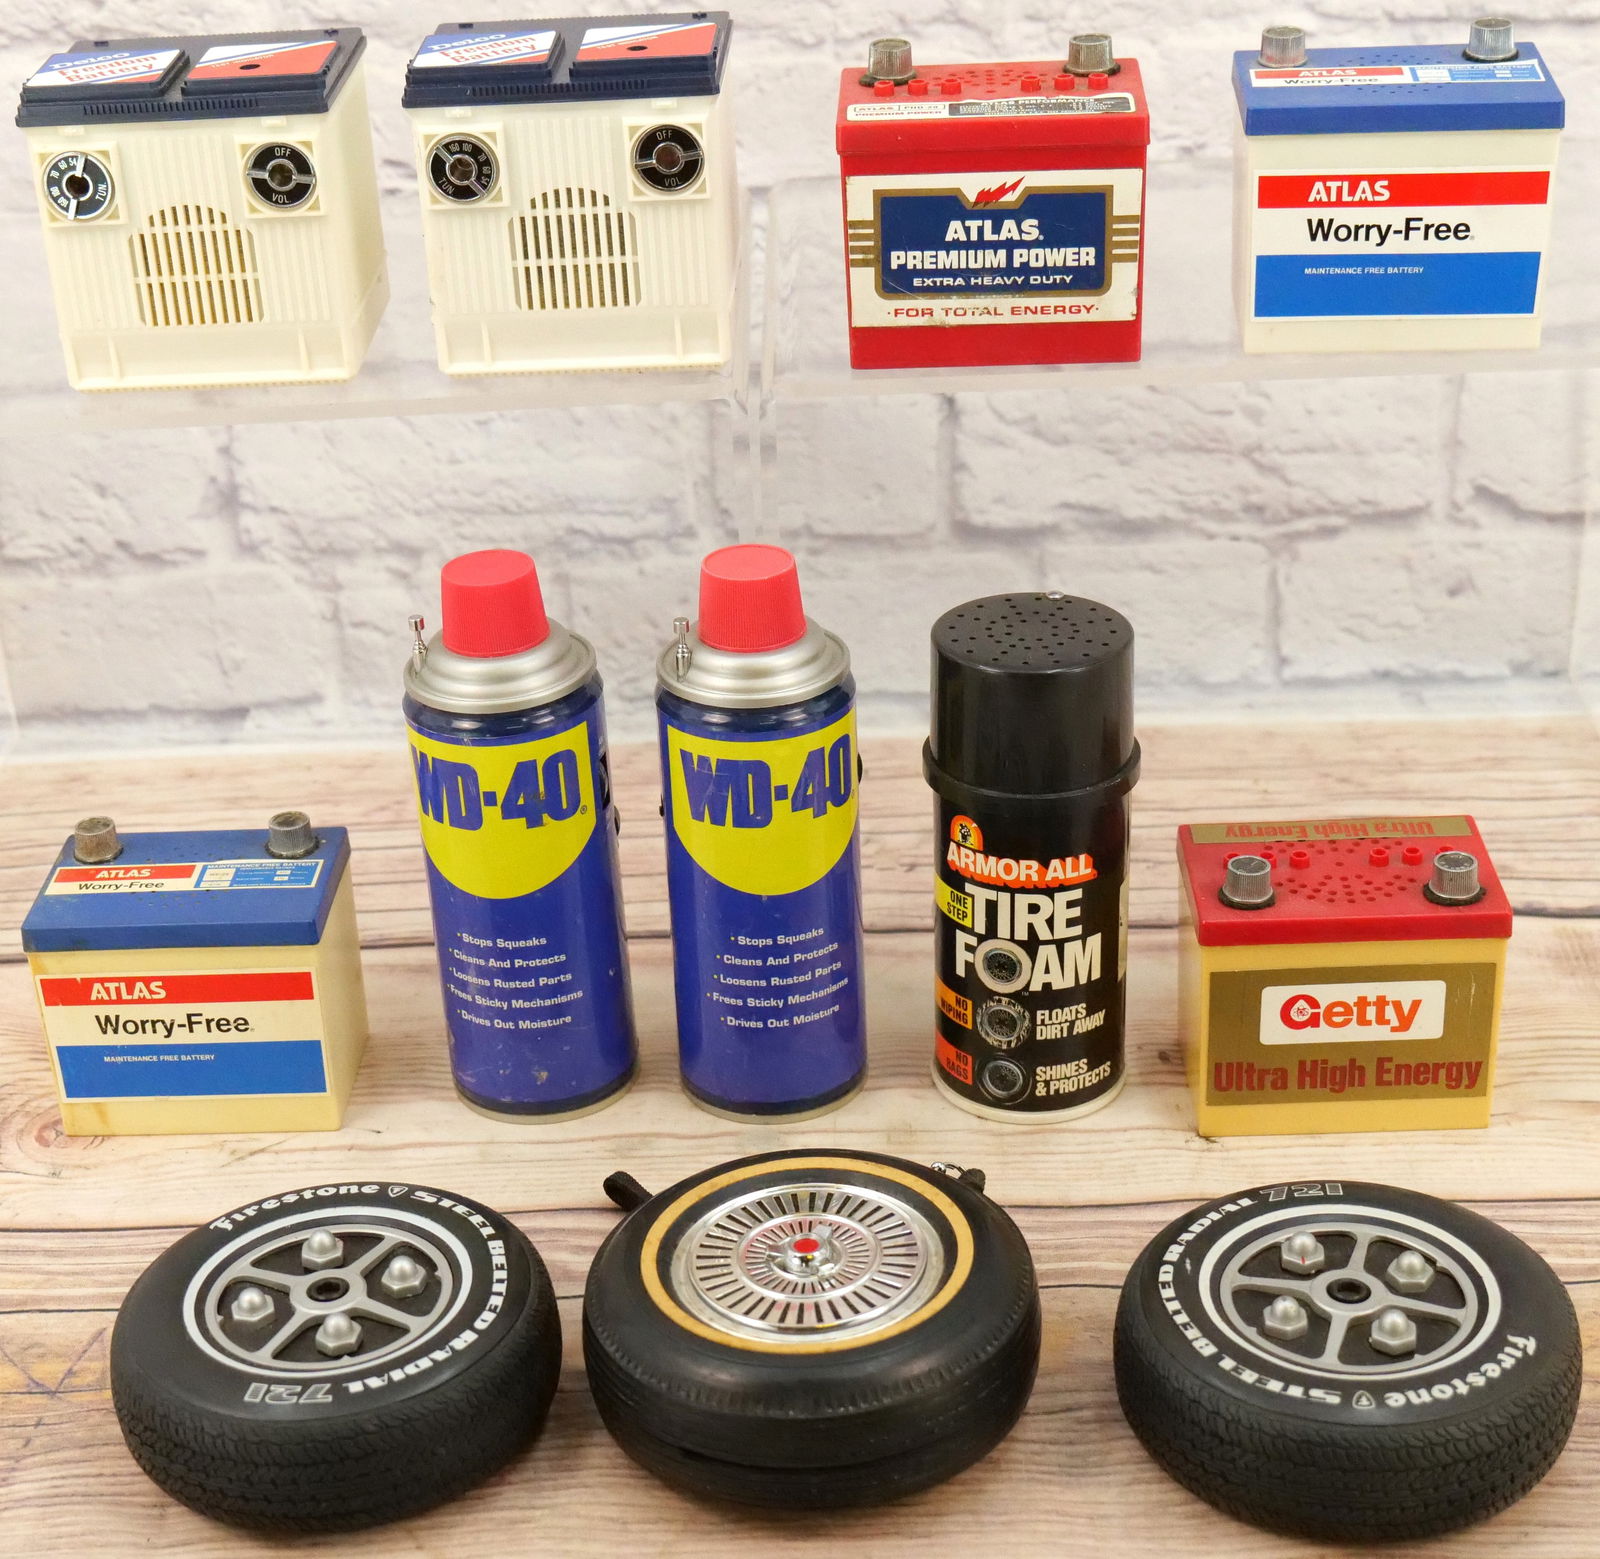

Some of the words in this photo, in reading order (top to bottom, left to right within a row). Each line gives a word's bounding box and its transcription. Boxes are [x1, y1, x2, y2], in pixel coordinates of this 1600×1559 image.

[440, 37, 536, 57] Freedom
[450, 44, 537, 63] Battery
[58, 56, 158, 76] Freedom
[65, 64, 154, 82] Battery
[1284, 77, 1379, 86] Worry-Free
[656, 130, 673, 141] OFF
[274, 147, 291, 157] OFF
[1308, 180, 1390, 202] ATLAS
[945, 219, 1041, 242] ATLAS
[1306, 217, 1471, 247] Worry-Free
[890, 249, 1008, 270] PREMIUM
[1013, 247, 1096, 268] POWER
[913, 277, 966, 287] EXTRA
[971, 275, 1025, 286] HEAVY
[1030, 274, 1074, 285] DUTY
[1304, 267, 1362, 275] MAINTENANCE
[1364, 266, 1385, 274] FREE
[1387, 266, 1424, 274] BATTERY
[894, 307, 934, 318] FOR
[941, 306, 1004, 317] TOTAL
[1011, 304, 1096, 316] ENERGY
[410, 743, 582, 831] WD-40
[679, 733, 851, 829] WD-40
[1225, 824, 1309, 839] Energy
[1313, 822, 1370, 838] High
[1374, 821, 1435, 836] Ultra
[947, 840, 1039, 882] ARMOR
[1045, 853, 1093, 882] ALL
[96, 869, 151, 879] ATLAS
[78, 882, 164, 891] Worry-Free
[949, 890, 969, 910] ONE
[964, 882, 1083, 941] TIRE
[946, 902, 968, 922] STEP
[462, 932, 493, 948] Stops
[496, 936, 547, 950] Squeaks
[737, 935, 773, 948] Stops
[776, 927, 825, 945] Squeaks
[453, 949, 485, 966] Cleans
[488, 958, 511, 969] And
[514, 953, 567, 968] Protects
[723, 954, 763, 967] Cleans
[766, 955, 790, 966] And
[793, 941, 839, 963] Protects
[955, 929, 1102, 994] FOAM
[452, 967, 491, 987] Loosens
[494, 978, 535, 989] Rusted
[539, 972, 573, 987] Parts
[720, 974, 767, 987] Loosens
[770, 970, 812, 986] Rusted
[815, 961, 842, 978] Parts
[90, 981, 166, 1000] ATLAS
[450, 984, 473, 1002] Frees
[474, 994, 508, 1010] Sticky
[511, 989, 584, 1009] Mechanisms
[713, 992, 743, 1006] Frees
[746, 997, 784, 1009] Sticky
[787, 976, 849, 1005] Mechanisms
[940, 997, 969, 1025] WIPING
[955, 995, 968, 1011] NO
[1036, 1003, 1087, 1025] FLOATS
[1280, 994, 1422, 1033] Getty
[95, 1013, 250, 1038] Worry-Free
[461, 1009, 491, 1027] Drives
[494, 1019, 515, 1030] Out
[518, 1015, 572, 1030] Moisture
[726, 1016, 764, 1029] Drives
[767, 1018, 790, 1028] Out
[793, 1003, 840, 1026] Moisture
[1036, 1023, 1070, 1041] DIRT
[1073, 1009, 1106, 1034] AWAY
[104, 1055, 158, 1063] MAINTENANCE
[181, 1054, 215, 1062] BATTERY
[946, 1057, 969, 1081] RAGS
[955, 1051, 968, 1067] NO
[1036, 1058, 1088, 1082] SHINES
[1035, 1080, 1047, 1096] &
[1050, 1061, 1111, 1095] PROTECTS
[1213, 1061, 1289, 1093] Ultra
[1297, 1058, 1366, 1093] High
[1375, 1056, 1483, 1090] Energy
[1259, 1182, 1344, 1202] 721
[209, 1184, 381, 1232] Firestone
[410, 1190, 497, 1239] STEEL
[1162, 1197, 1258, 1264] RADIAL
[473, 1239, 508, 1331] BELTED
[1157, 1269, 1219, 1358] BELTED
[342, 1329, 479, 1393] RADIAL
[1384, 1333, 1537, 1408] Firestone
[1216, 1353, 1343, 1405] STEEL
[244, 1382, 334, 1405] 721
